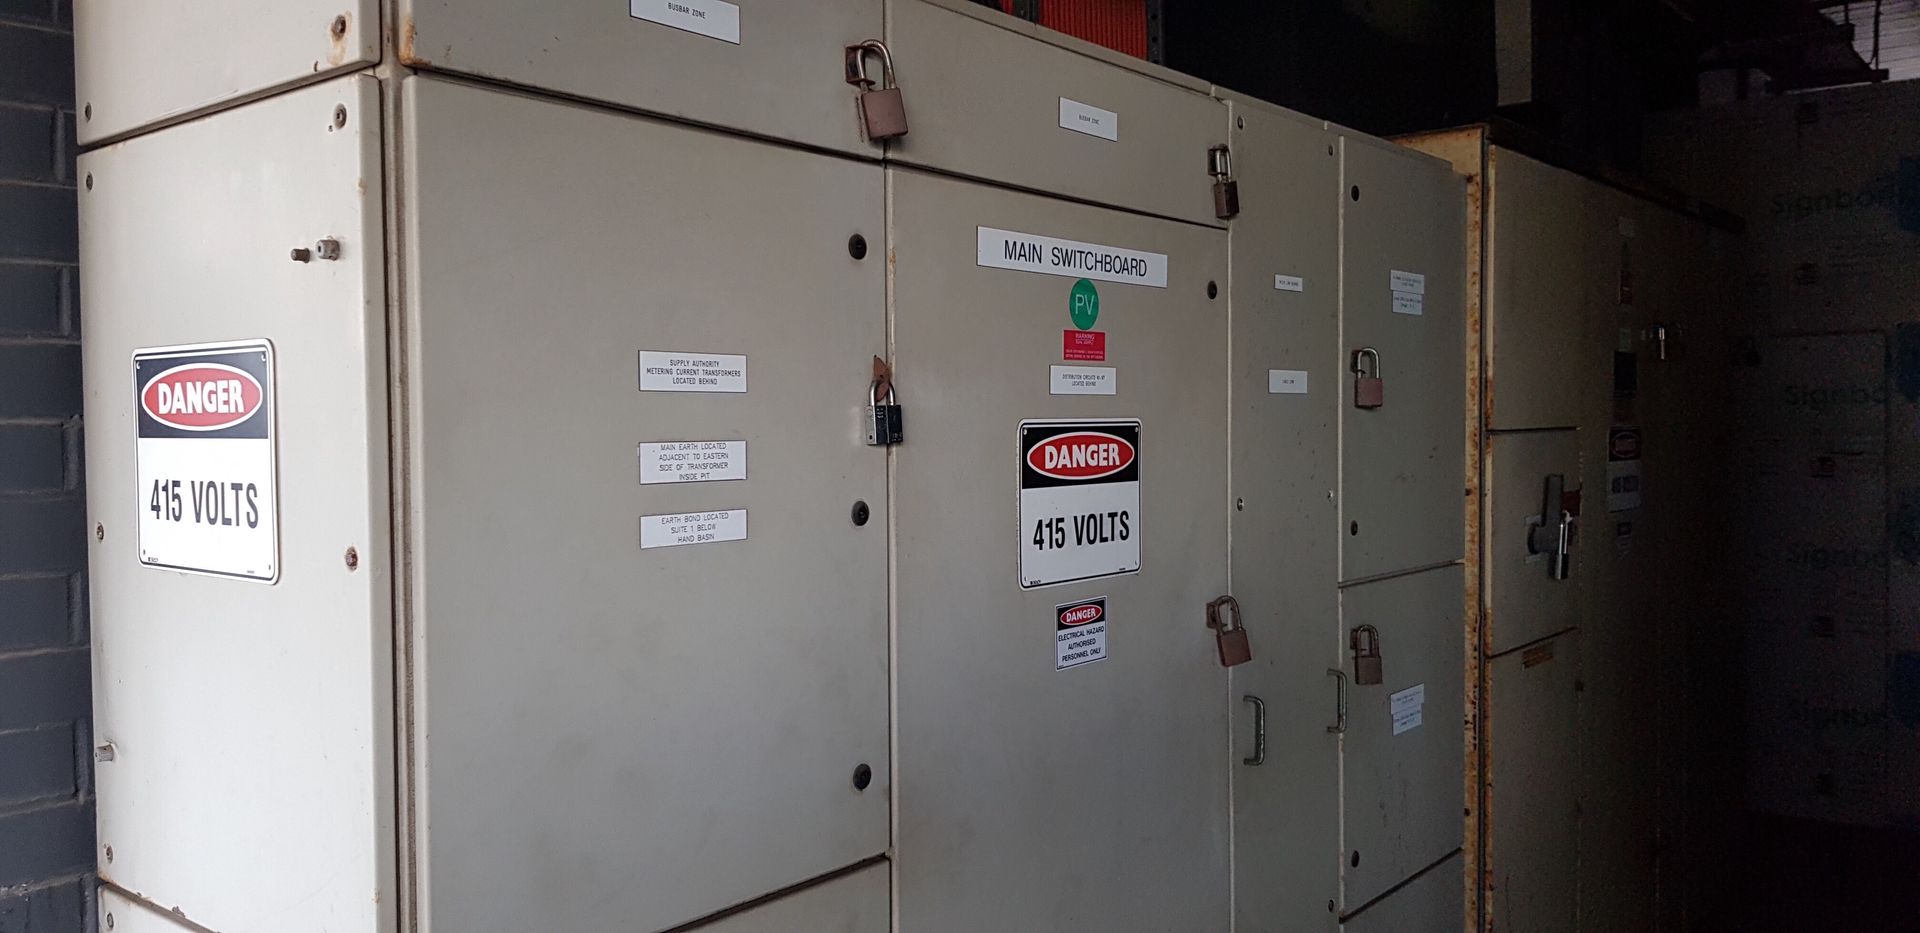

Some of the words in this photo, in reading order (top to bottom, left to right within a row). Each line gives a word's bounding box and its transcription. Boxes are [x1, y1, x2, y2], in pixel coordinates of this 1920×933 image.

[668, 2, 689, 14] BUSBAR
[692, 8, 706, 19] ZONE
[1004, 240, 1042, 264] MAIN
[1052, 246, 1147, 277] SWITCHBOARD
[1075, 294, 1095, 316] PV
[676, 368, 700, 376] CURRENT
[702, 369, 741, 377] TRANSFORMERS
[158, 380, 244, 414] DANGER
[1044, 444, 1120, 469] DANGER
[687, 462, 728, 470] TRANSFORMER
[701, 472, 710, 480] PIT
[150, 479, 182, 522] 415
[191, 480, 259, 529] VOLTS
[704, 512, 729, 521] LOCATED
[671, 526, 687, 534] SUITE
[1033, 517, 1066, 550] 415
[1073, 510, 1130, 546] VOLTS
[678, 535, 694, 543] HAND
[698, 534, 714, 542] BASIN
[1066, 608, 1096, 622] DANGER
[1058, 630, 1085, 642] ELECTRICAL
[1087, 626, 1104, 635] HAZARD
[1068, 638, 1096, 650] AUTHORISED
[1062, 650, 1089, 662] PERSONNEL
[1090, 647, 1102, 655] ONLY
